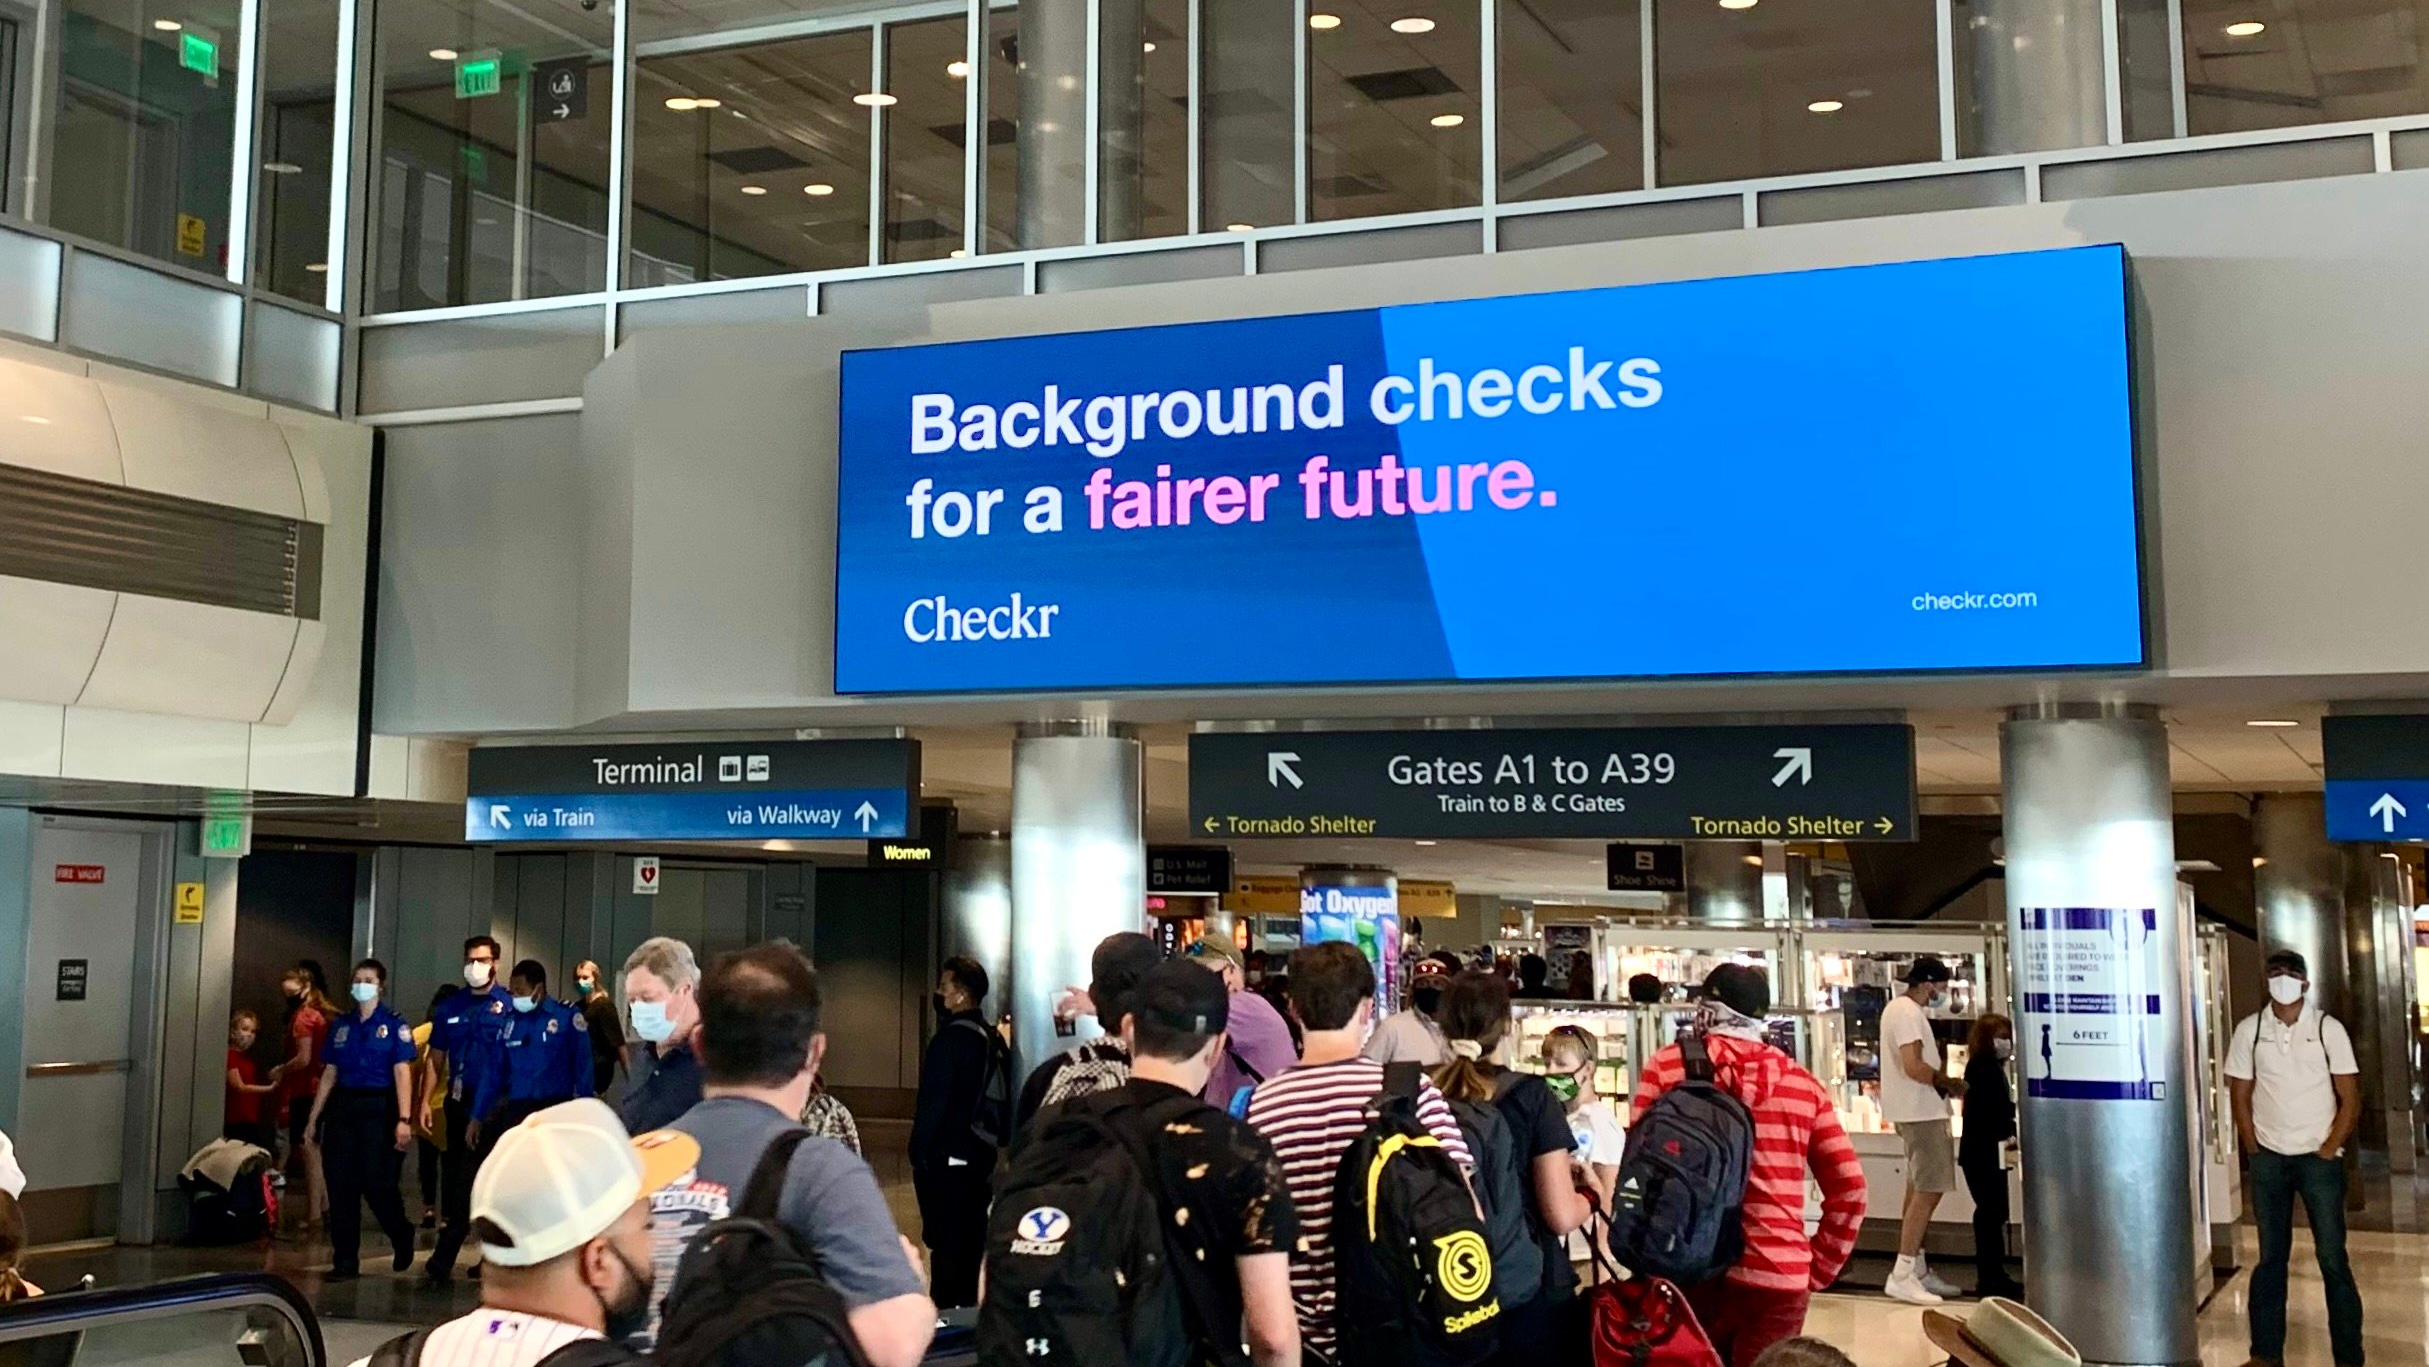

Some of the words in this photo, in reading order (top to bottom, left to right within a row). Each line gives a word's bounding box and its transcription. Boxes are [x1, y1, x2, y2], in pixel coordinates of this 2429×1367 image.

[911, 365, 1344, 460] Background
[1371, 347, 1663, 425] checks
[906, 479, 1004, 539] for
[1023, 487, 1063, 534] a
[1084, 468, 1280, 530] fairer
[1298, 455, 1557, 519] future.
[1911, 590, 2038, 611] checkr.com
[903, 592, 1060, 643] Checkr
[593, 755, 703, 785] Terminal
[1388, 755, 1483, 785] Gates
[1494, 755, 1535, 784] A1
[1551, 757, 1589, 784] to
[1601, 754, 1676, 784] A39
[1436, 794, 1485, 813] Train
[1488, 796, 1510, 813] to
[1513, 795, 1527, 813] B
[1531, 794, 1547, 813] &
[1551, 794, 1566, 813] C
[1569, 794, 1626, 813] Gates
[523, 808, 548, 828] via
[552, 807, 595, 827] Train
[727, 809, 753, 825] via
[758, 804, 842, 828] Walkway
[1227, 815, 1305, 834] Tornado
[1310, 815, 1377, 834] Shelter
[1690, 815, 1782, 835] Tornado
[1787, 815, 1865, 835] Shelter
[883, 844, 931, 861] Women
[1614, 874, 1641, 886] Shoe
[1646, 875, 1677, 887] Shine
[2073, 1028, 2081, 1040] 6
[2082, 1030, 2109, 1040] FEET
[1028, 1211, 1062, 1239] Y
